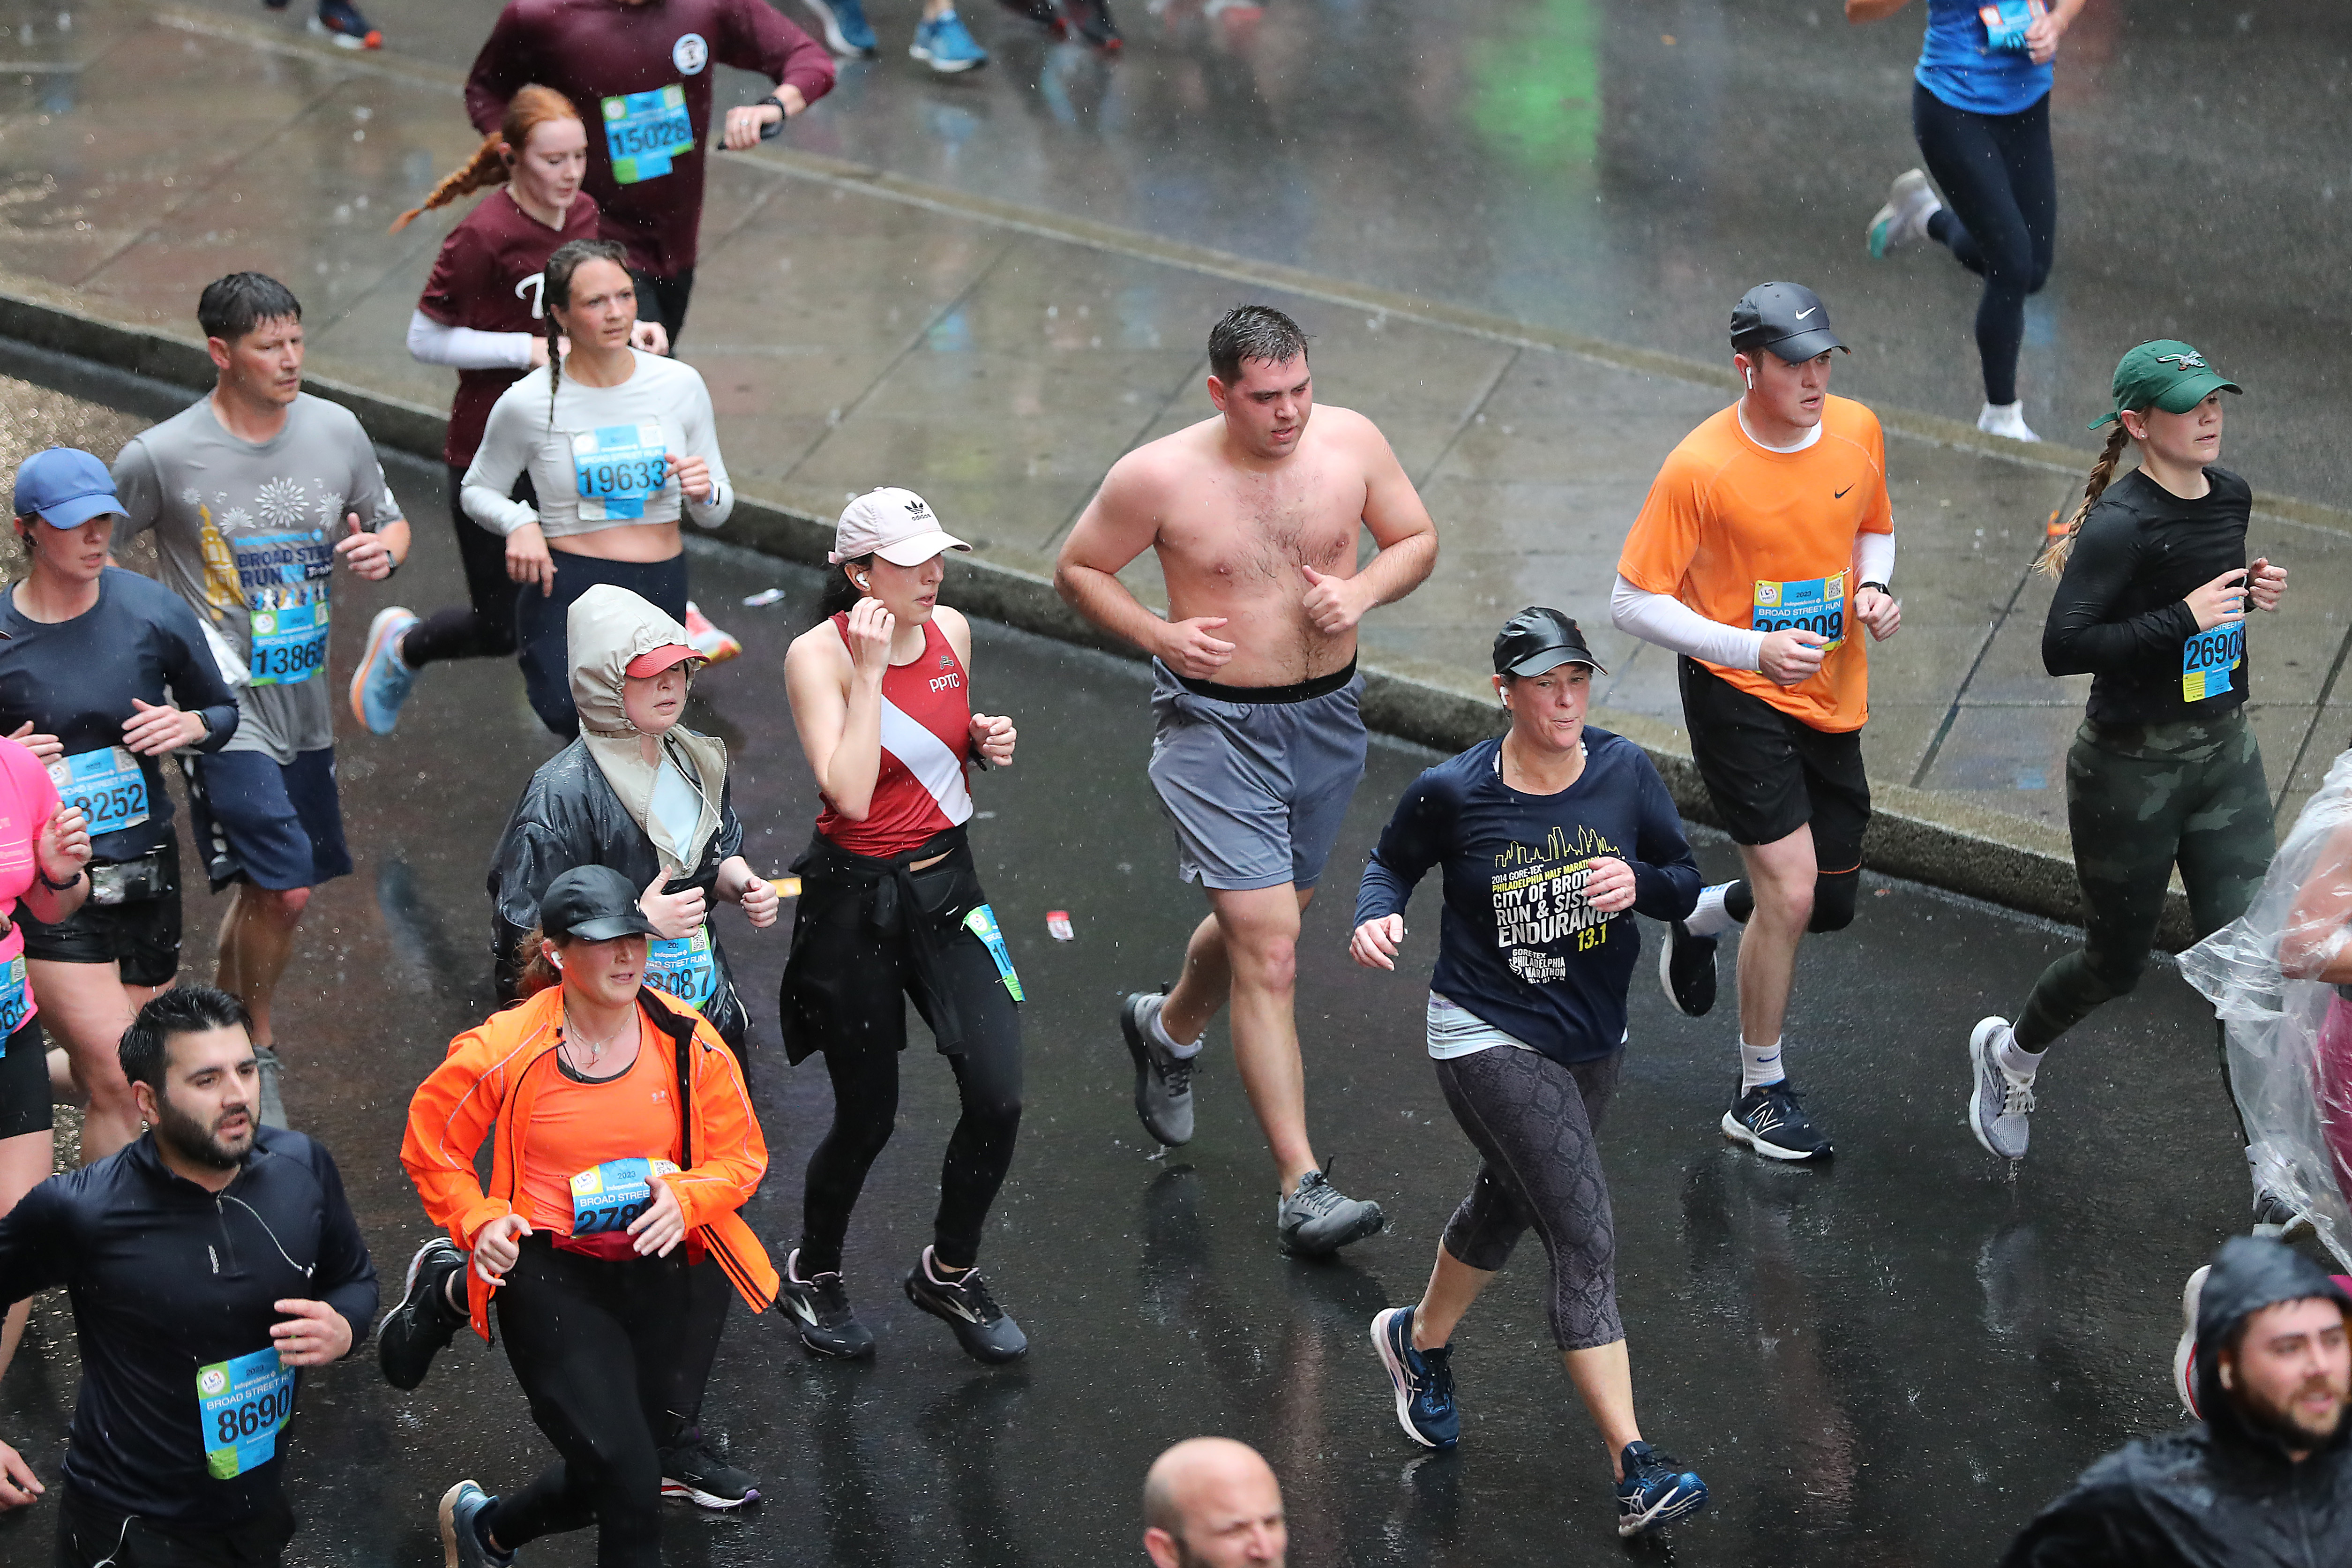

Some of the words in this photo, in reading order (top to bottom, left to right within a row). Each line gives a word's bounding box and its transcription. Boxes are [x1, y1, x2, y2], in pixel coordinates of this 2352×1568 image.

[581, 460, 665, 494] 19633
[238, 549, 293, 567] BROAD
[239, 568, 283, 587] RUN
[1792, 605, 1823, 615] STREET
[1825, 600, 1841, 610] RUN
[929, 673, 960, 693] PPTC
[75, 783, 145, 824] 8252
[1491, 874, 1507, 885] 2014
[1492, 873, 1544, 893] PHILADELPHIA
[1545, 867, 1562, 881] HALF
[1493, 889, 1524, 908] CITY
[1528, 882, 1548, 902] OF
[1495, 904, 1530, 926] RUN
[1536, 899, 1549, 919] &
[1577, 923, 1607, 952] 13.1
[690, 954, 707, 963] RUN
[1512, 956, 1566, 969] PHILADELPHIA
[1525, 967, 1566, 979] MARATHON
[618, 1171, 636, 1179] 2023
[606, 1182, 643, 1191] Independence
[580, 1195, 615, 1207] BROAD
[618, 1189, 651, 1201] STREE
[234, 1373, 270, 1390] Independence
[206, 1393, 244, 1410] BROAD
[245, 1378, 279, 1398] STREET
[218, 1385, 289, 1444] 8690
